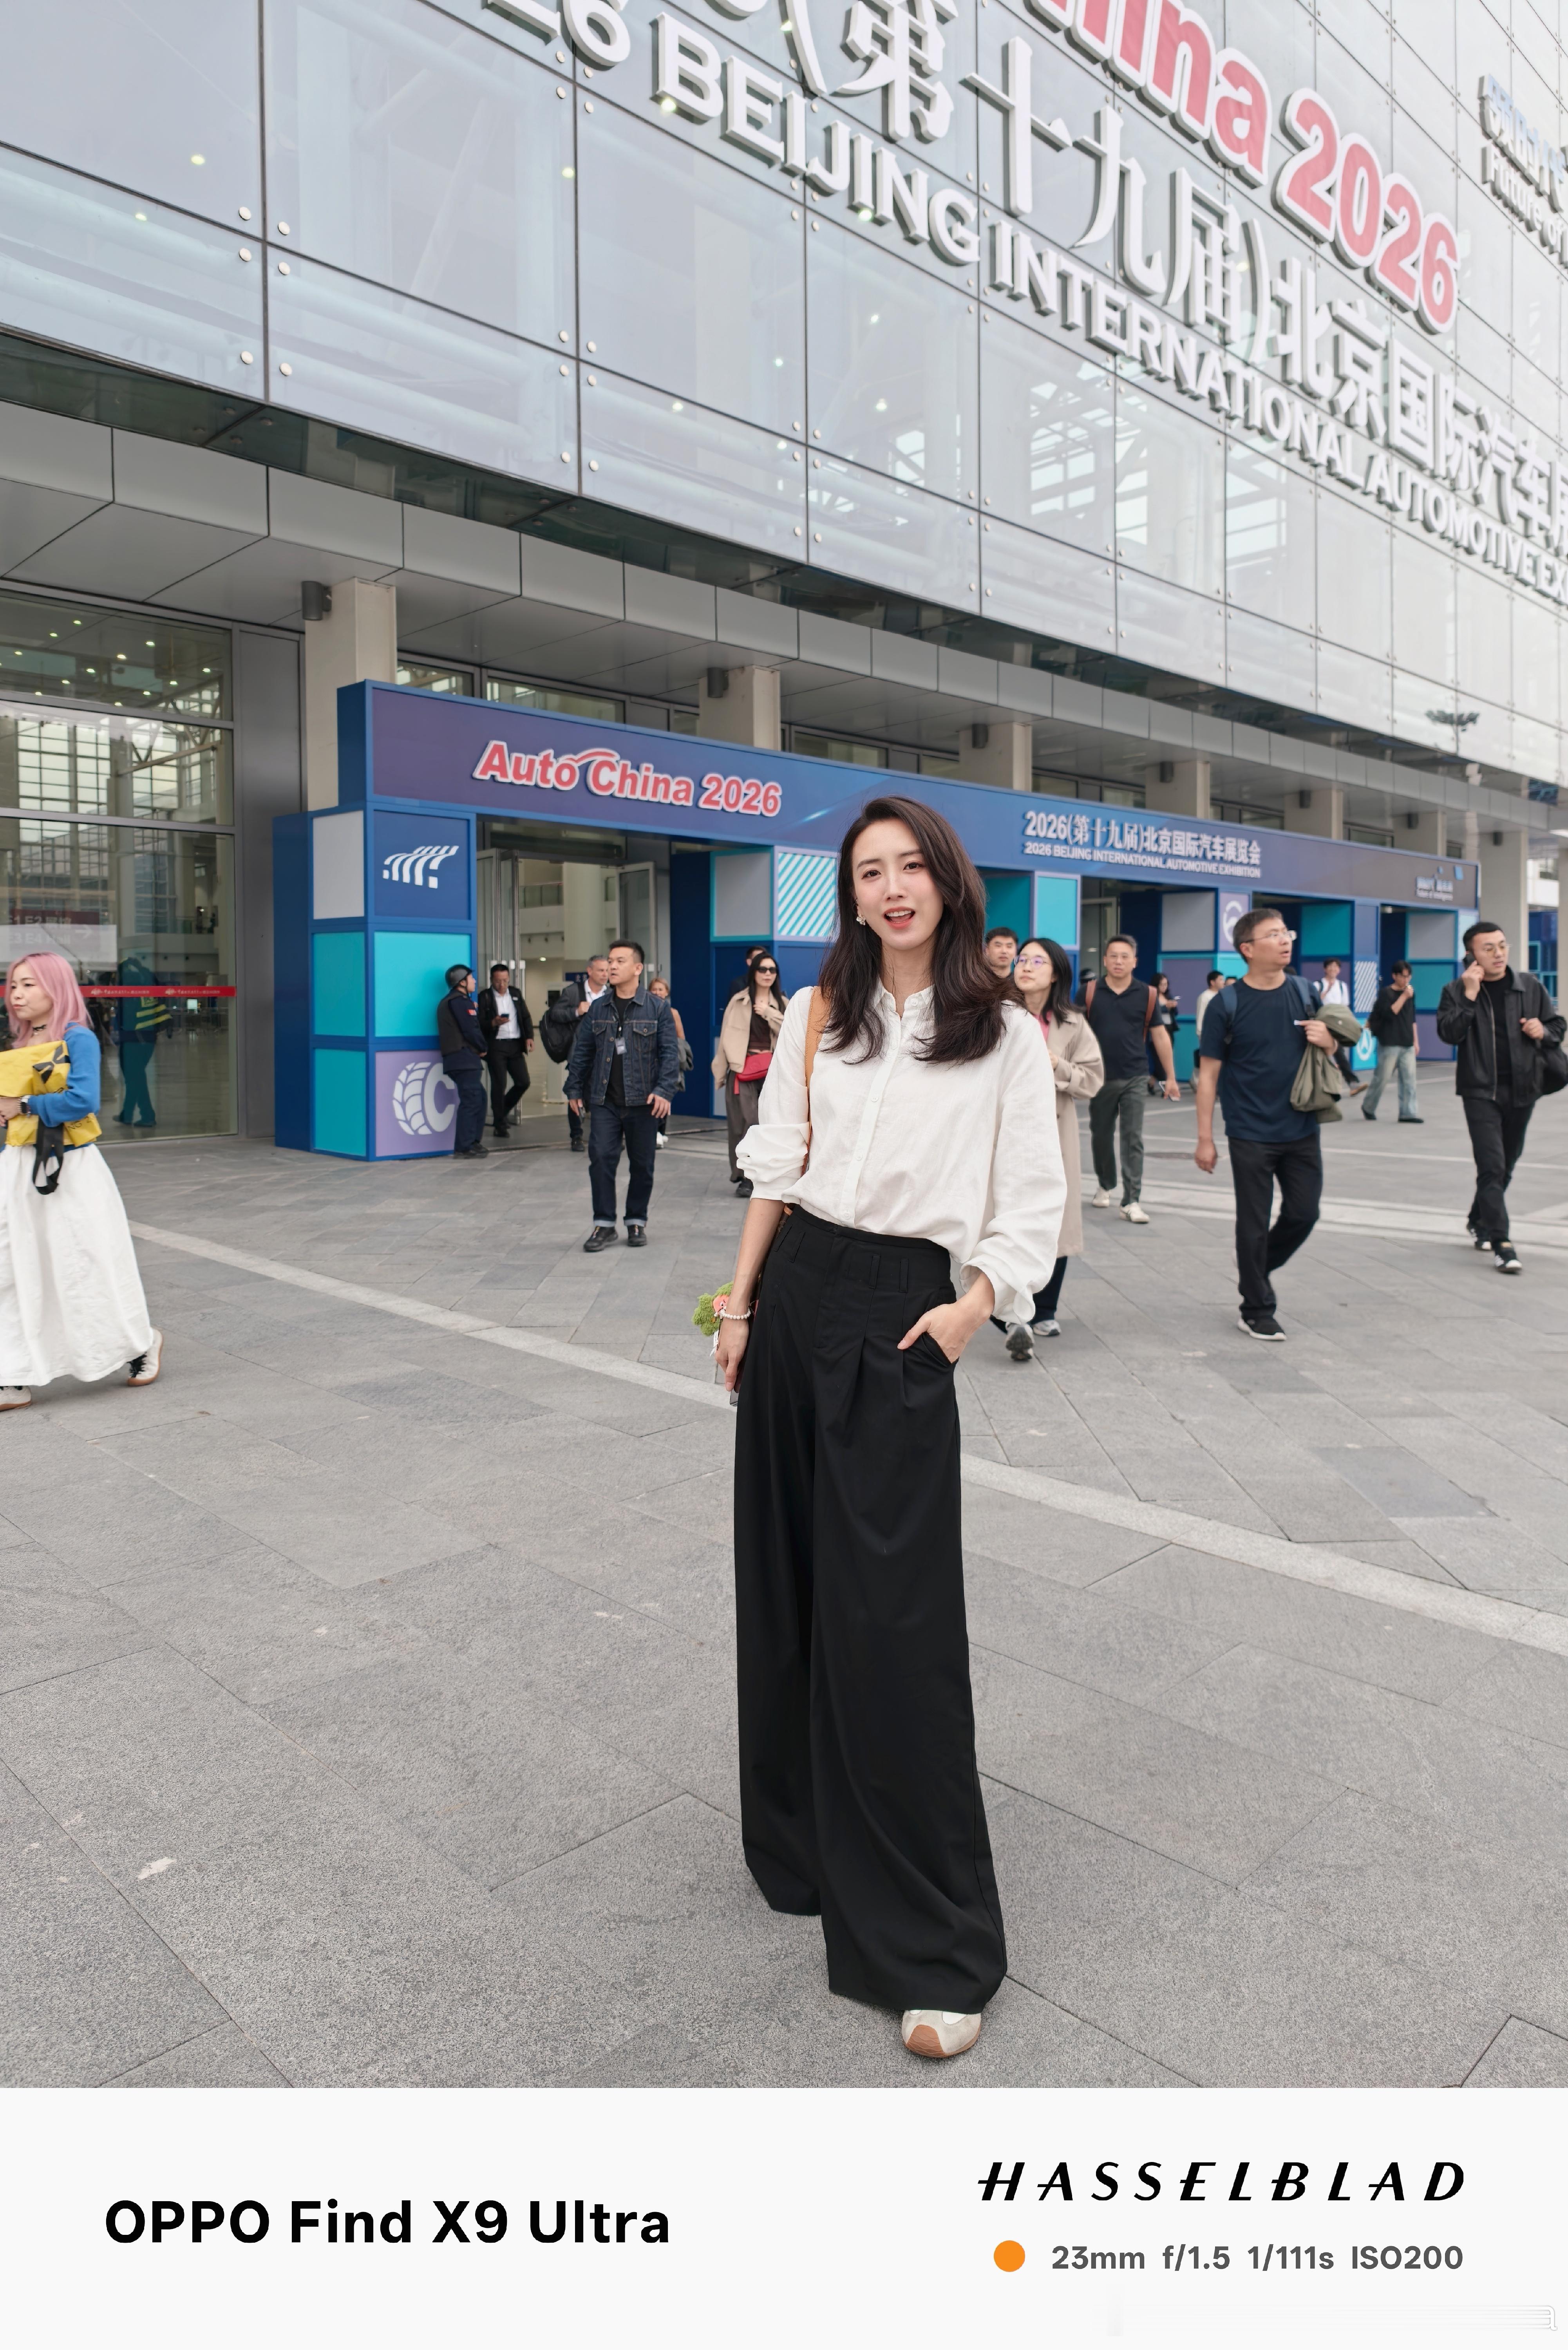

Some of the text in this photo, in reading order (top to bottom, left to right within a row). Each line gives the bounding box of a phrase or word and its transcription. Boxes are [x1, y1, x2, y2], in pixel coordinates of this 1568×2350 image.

[1030, 0, 1460, 334] ina 2026
[1483, 142, 1542, 231] Future
[485, 0, 1568, 606] 6 BEIJING INTERNATIONAL AUTOMOTIVE EX
[473, 740, 782, 817] Auto China 2026
[1024, 810, 1261, 865] 2026(第十九届)北京国际汽车展览会
[1024, 841, 1261, 879] 2026 BEIJING INTERNATIONAL AUTOMOTIVE EXHIBITION
